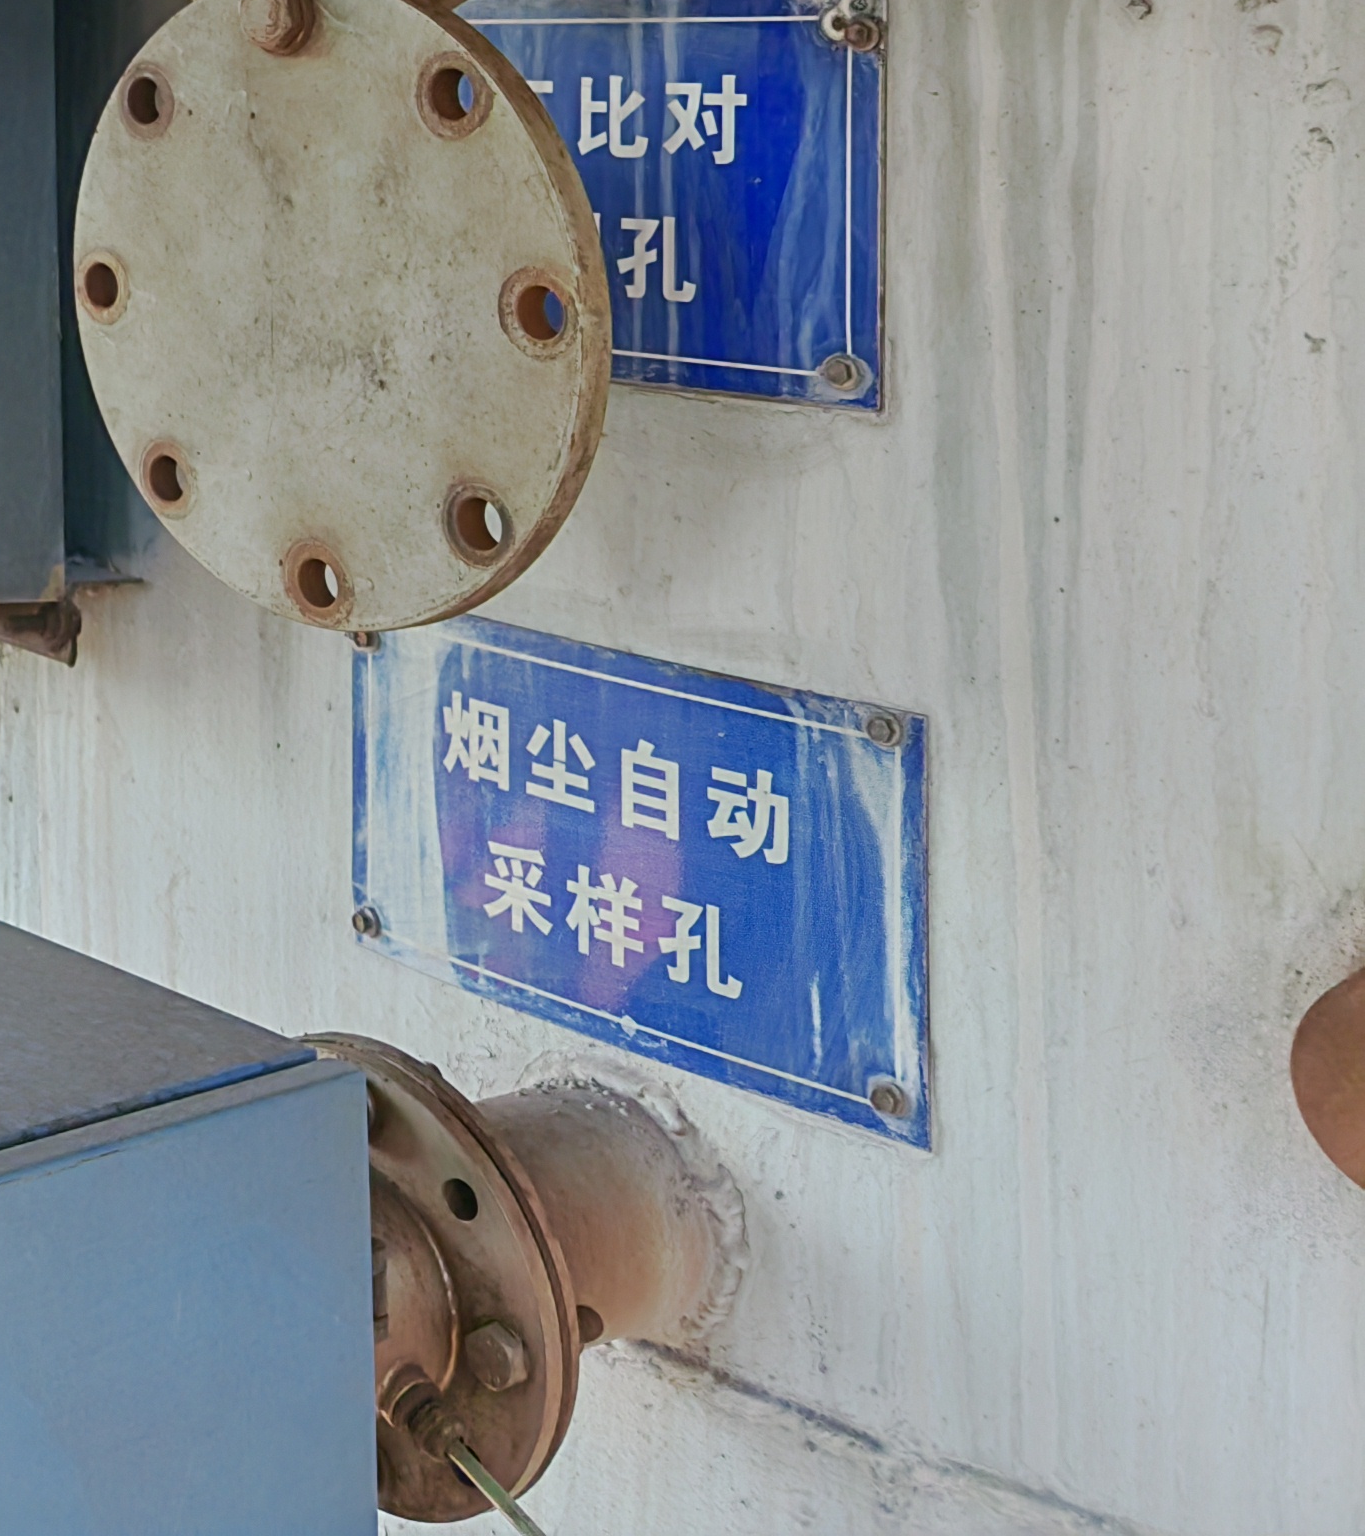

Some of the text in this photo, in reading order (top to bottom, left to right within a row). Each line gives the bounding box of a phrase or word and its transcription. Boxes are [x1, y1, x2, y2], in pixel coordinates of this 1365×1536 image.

[527, 74, 748, 165] 比对
[593, 214, 697, 303] 孔
[442, 690, 790, 865] 烟尘自动
[483, 840, 743, 1000] 采样孔
